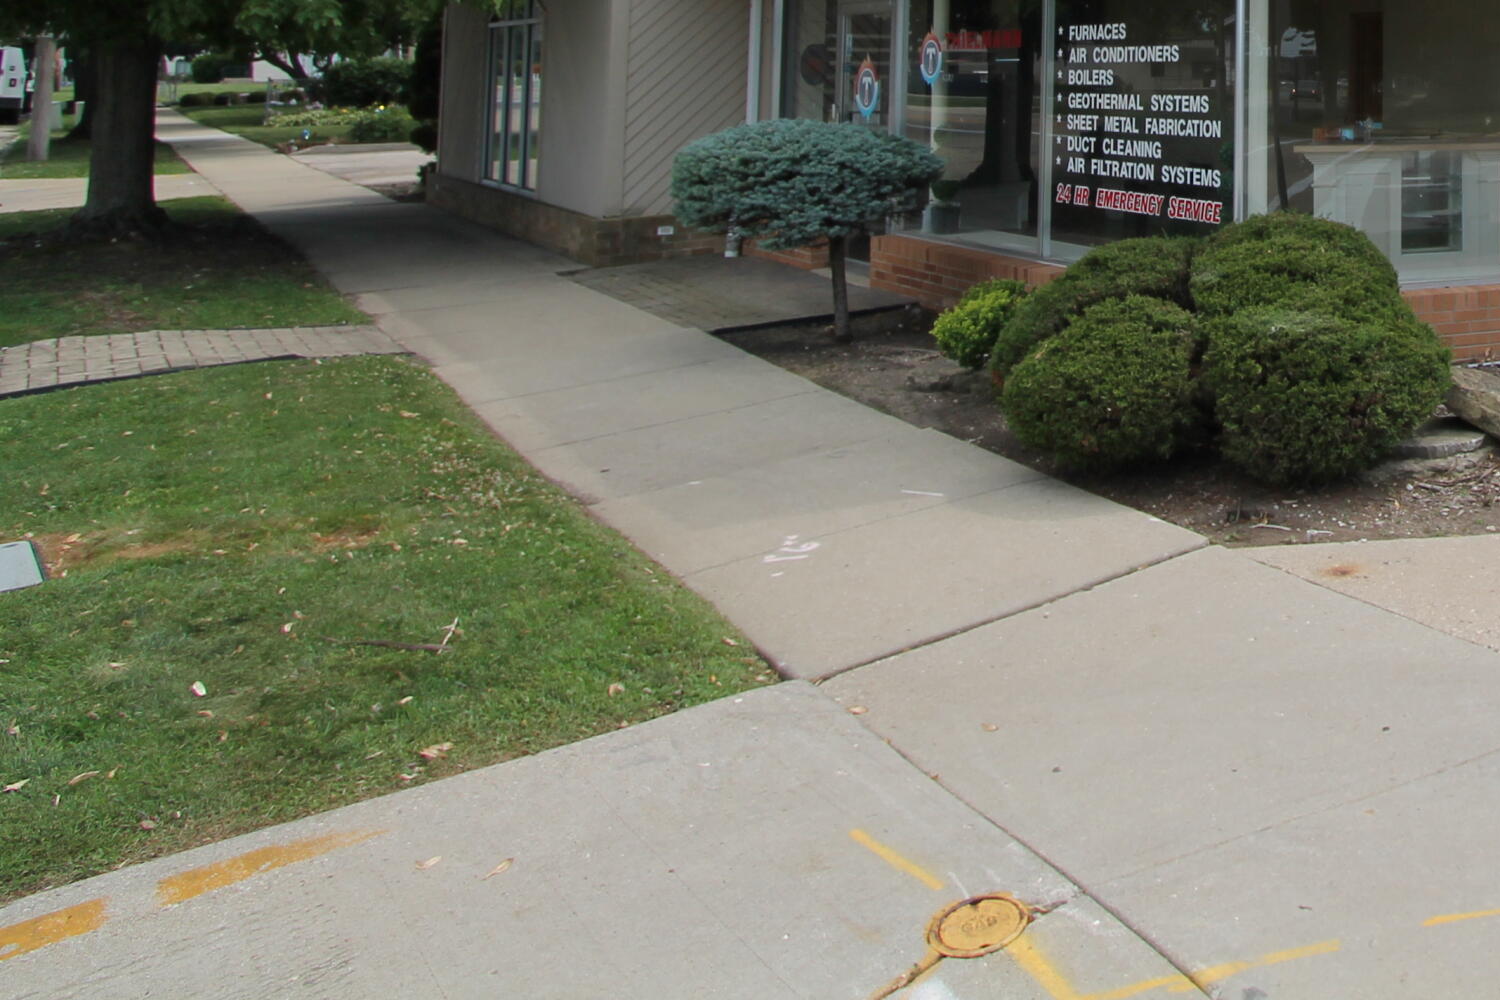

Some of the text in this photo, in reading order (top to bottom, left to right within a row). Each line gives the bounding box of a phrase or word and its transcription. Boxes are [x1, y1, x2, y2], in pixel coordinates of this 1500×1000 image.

[1069, 23, 1126, 41] FURNACES
[1069, 45, 1179, 63] AIR CONDITIONERS
[1068, 69, 1113, 85] BOILERS
[1068, 93, 1209, 113] GEOTHERMAL SYSTEMS
[1067, 115, 1221, 138] SHEET METAL FABRICATION
[1067, 136, 1161, 158] DUCT CLEANING
[1067, 157, 1221, 188] AIR FILTRATION SYSTEMS
[1056, 183, 1223, 224] 24 HR EMERGENCY SERVICE
